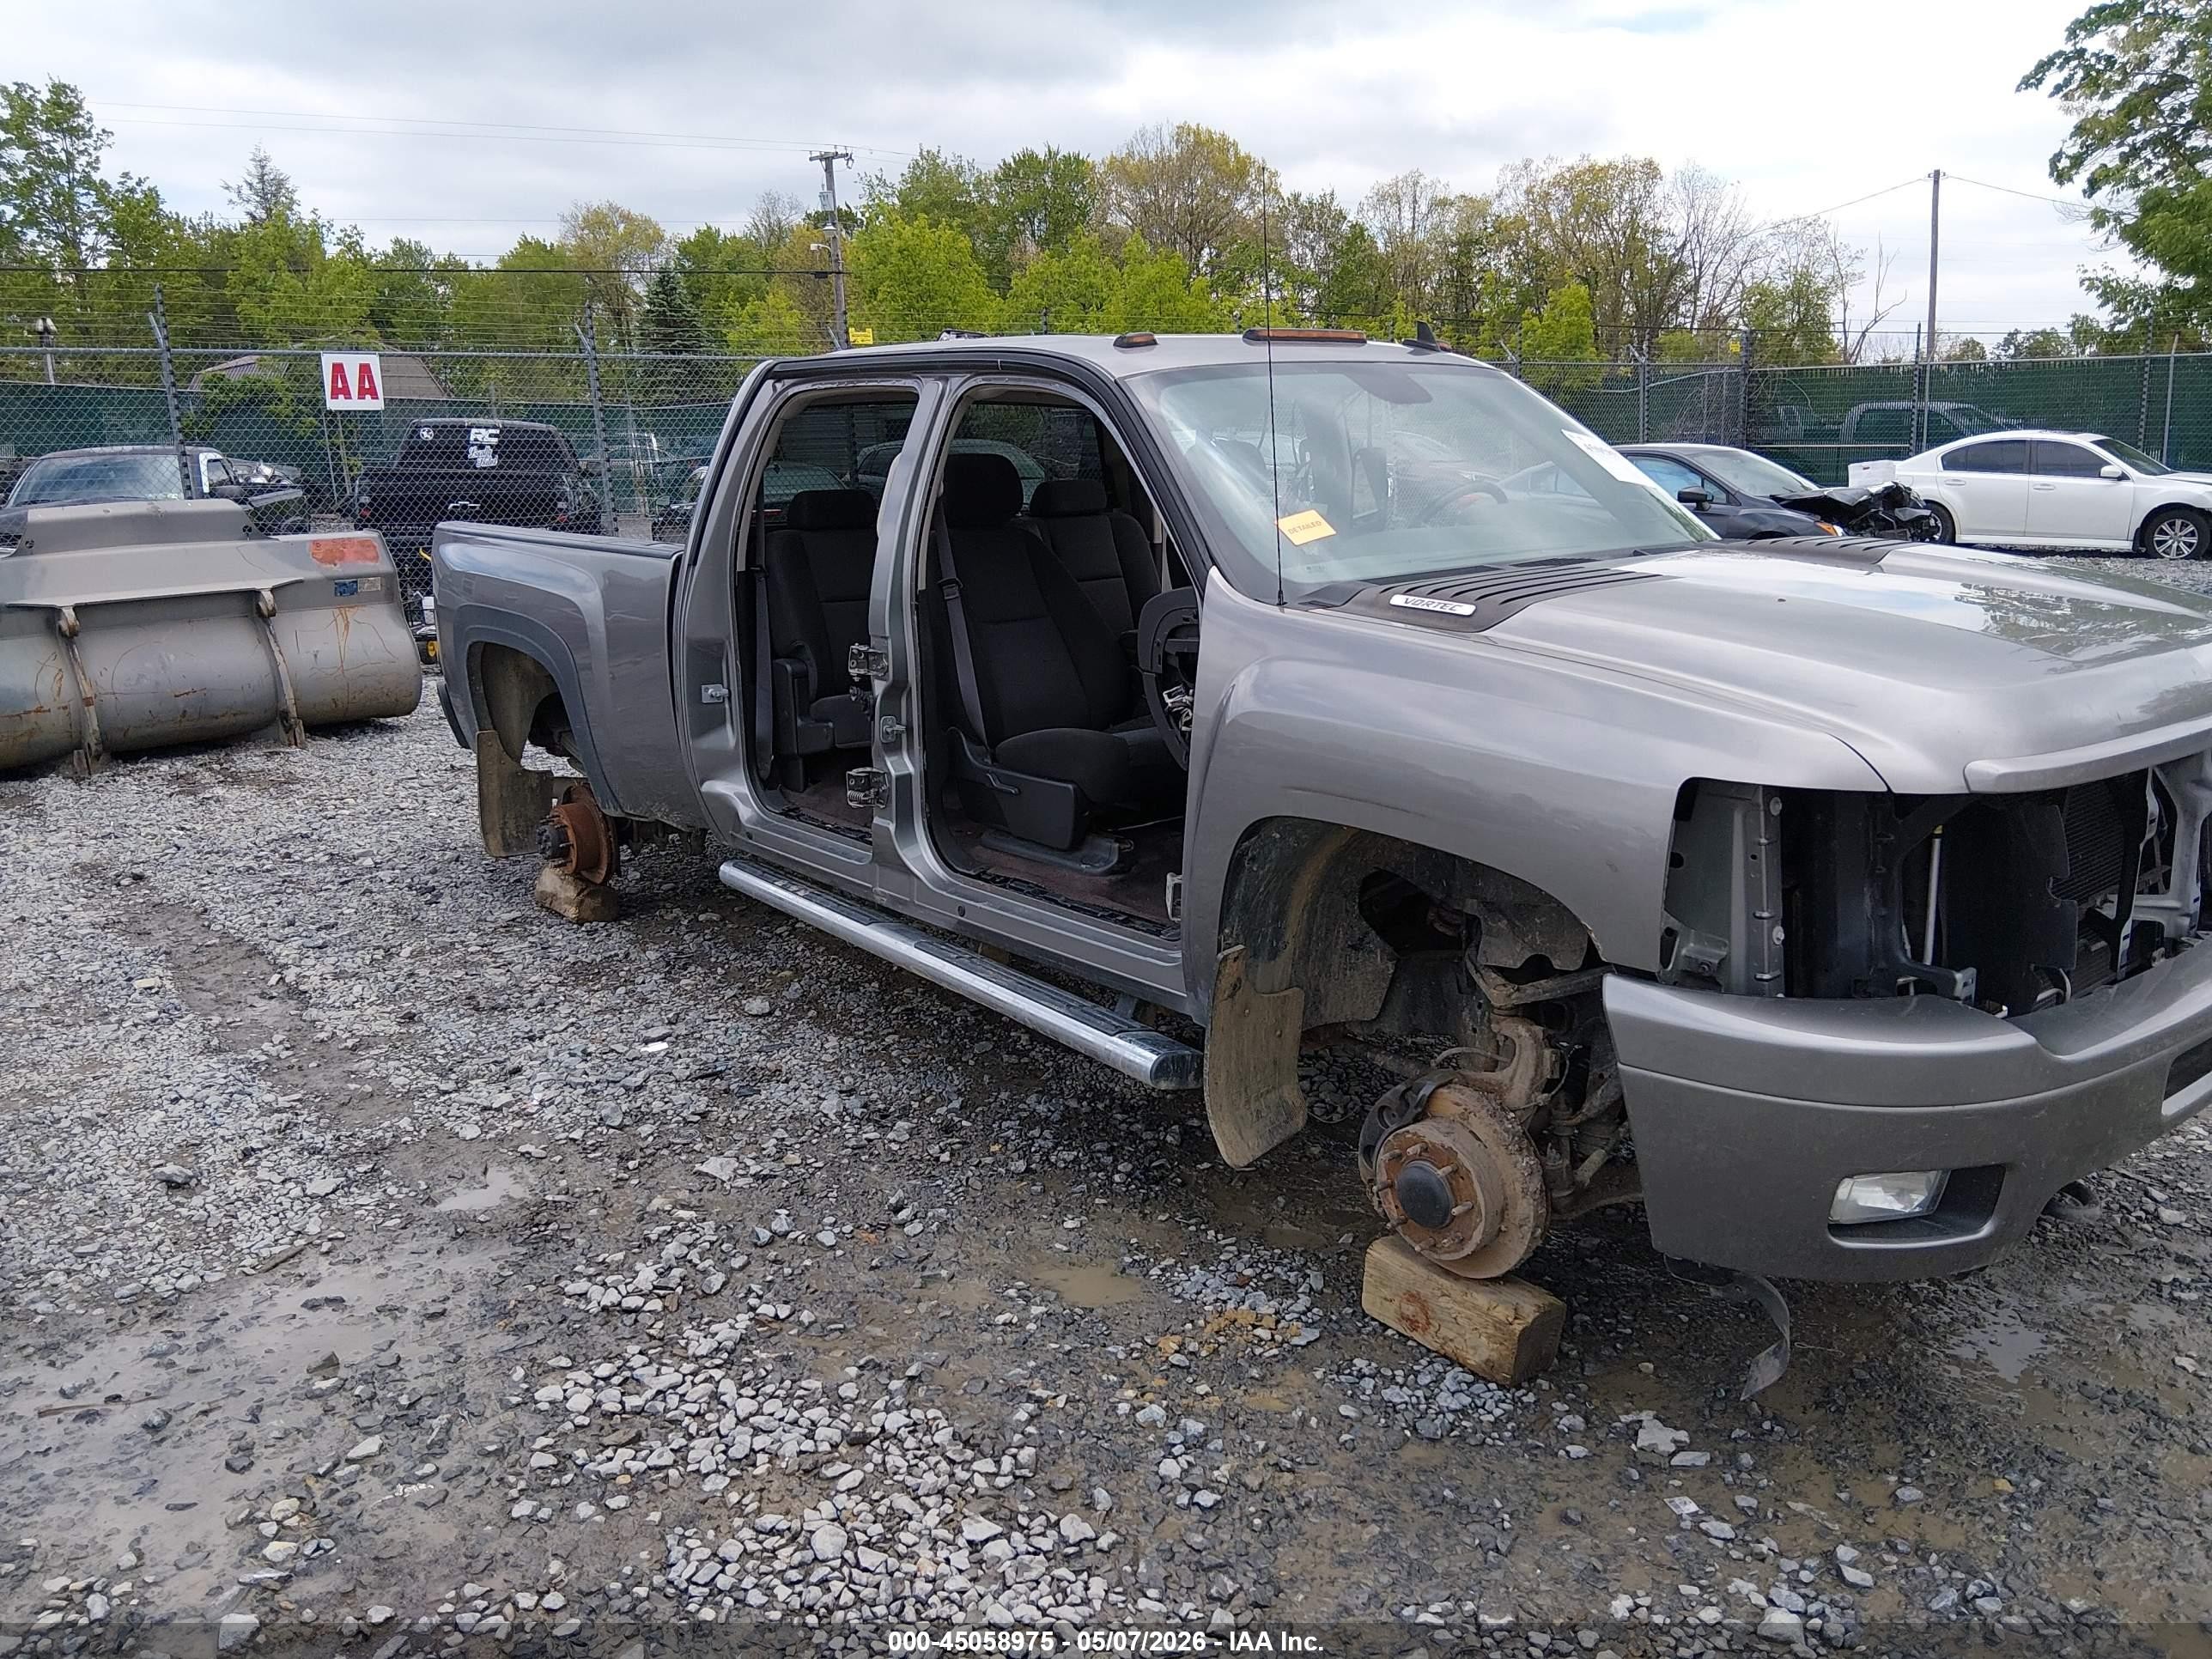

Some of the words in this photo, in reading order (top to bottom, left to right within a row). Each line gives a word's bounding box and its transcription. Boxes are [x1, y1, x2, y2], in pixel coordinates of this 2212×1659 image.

[331, 362, 380, 400] AA
[470, 428, 501, 443] RC
[1287, 520, 1322, 535] DETAILED
[1403, 597, 1464, 611] VORTEC
